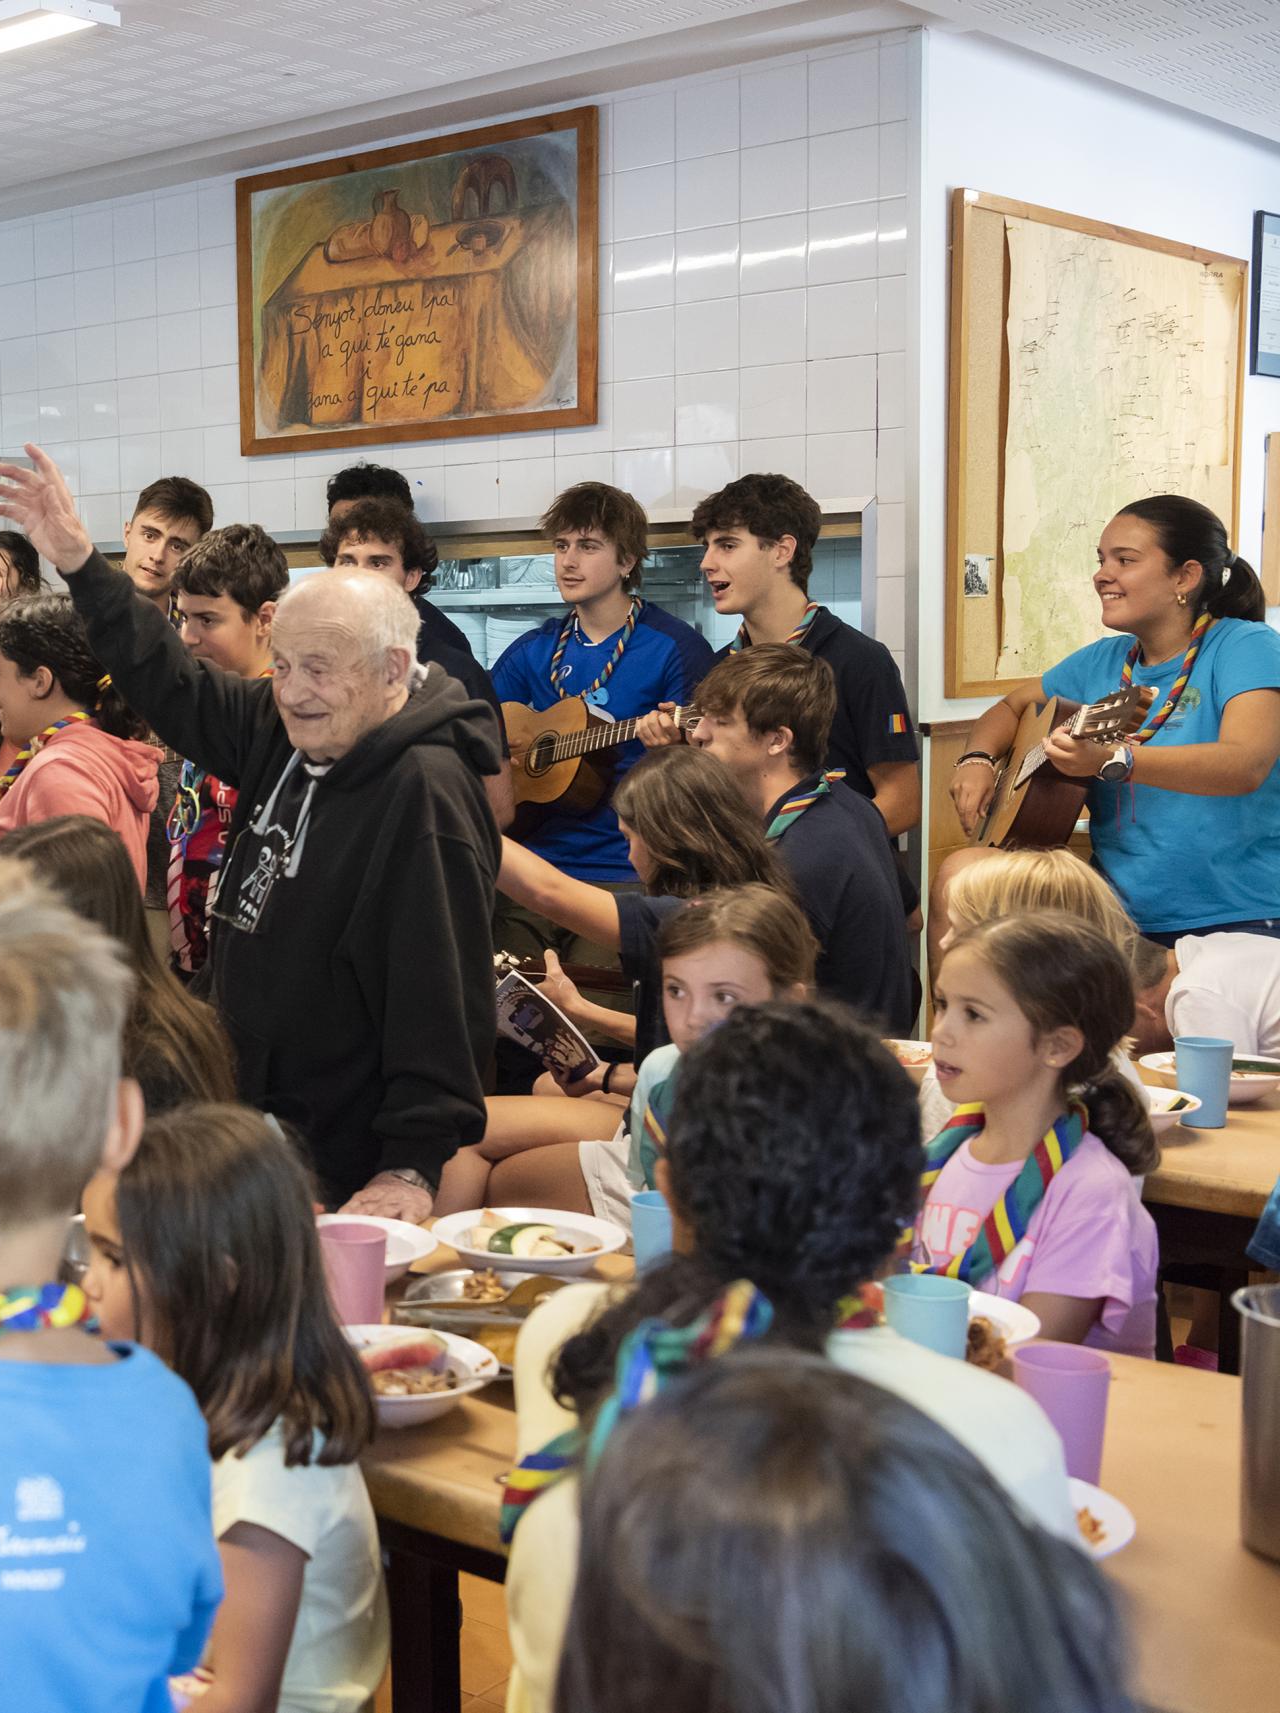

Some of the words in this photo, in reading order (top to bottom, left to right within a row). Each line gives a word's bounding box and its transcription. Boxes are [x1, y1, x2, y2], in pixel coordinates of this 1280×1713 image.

[287, 304, 362, 339] Senyor,
[364, 287, 415, 317] doneu
[321, 344, 333, 359] a
[340, 333, 371, 377] qui
[374, 319, 396, 353] té
[396, 330, 441, 366] gana
[304, 391, 343, 410] gana
[347, 390, 359, 402] a
[366, 382, 398, 420] qui
[402, 370, 426, 397] té
